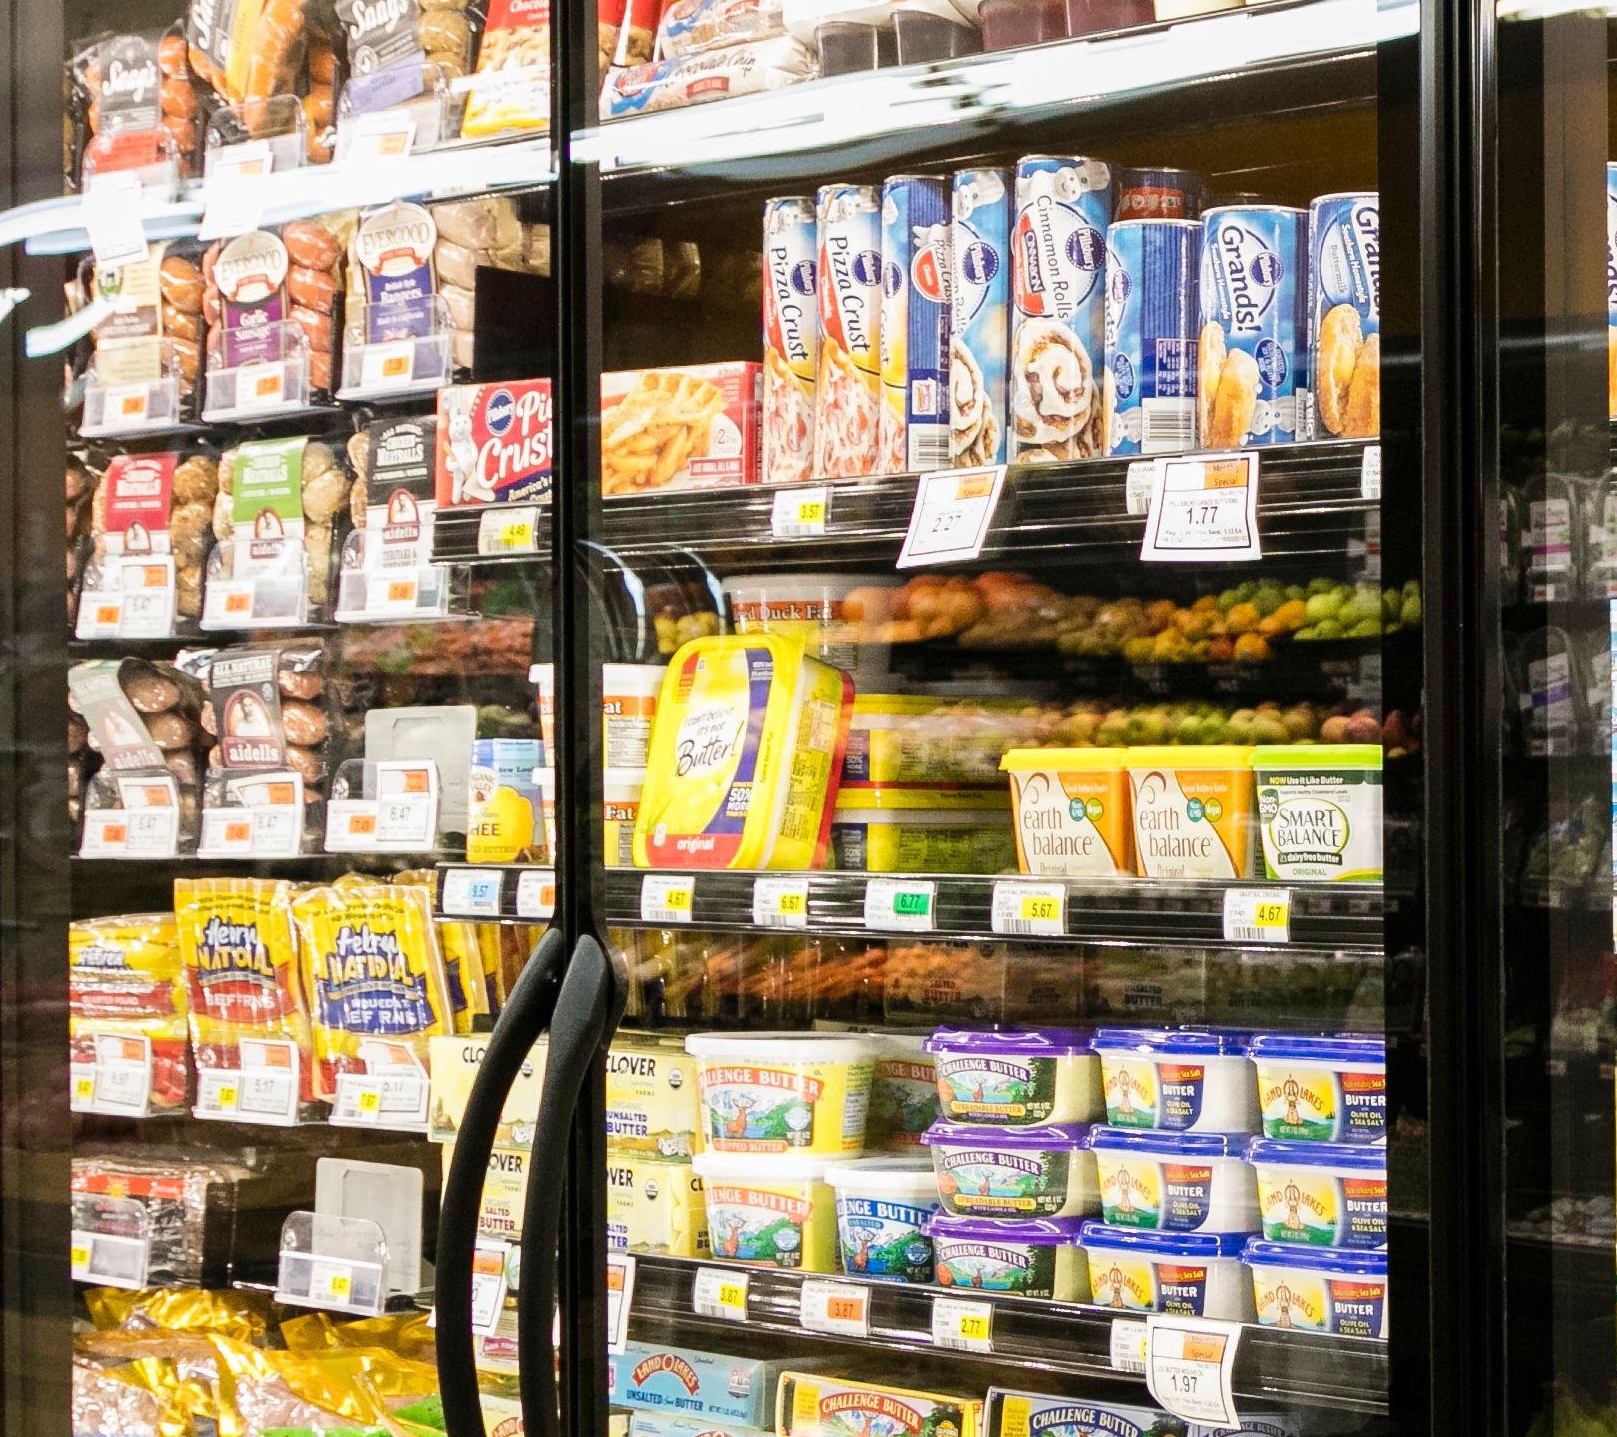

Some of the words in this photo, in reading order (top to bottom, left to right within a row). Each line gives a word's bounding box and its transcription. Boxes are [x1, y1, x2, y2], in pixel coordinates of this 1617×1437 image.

[363, 221, 430, 257] EVERGOOD
[1037, 195, 1065, 277] Cinnamon
[834, 236, 853, 291] Pizza
[845, 294, 869, 353] Crust
[1048, 280, 1069, 319] Rolls
[1186, 506, 1219, 525] 1.77
[1023, 806, 1062, 829] earth
[1279, 808, 1334, 828] SMART
[1033, 831, 1095, 855] balance
[1278, 828, 1341, 847] BALANCE
[470, 883, 491, 901] 9.57
[1259, 907, 1281, 921] 4.67
[626, 1390, 662, 1405] UNSALTED
[675, 1397, 704, 1411] BUTTER
[1032, 1407, 1098, 1429] CHALLENGE
